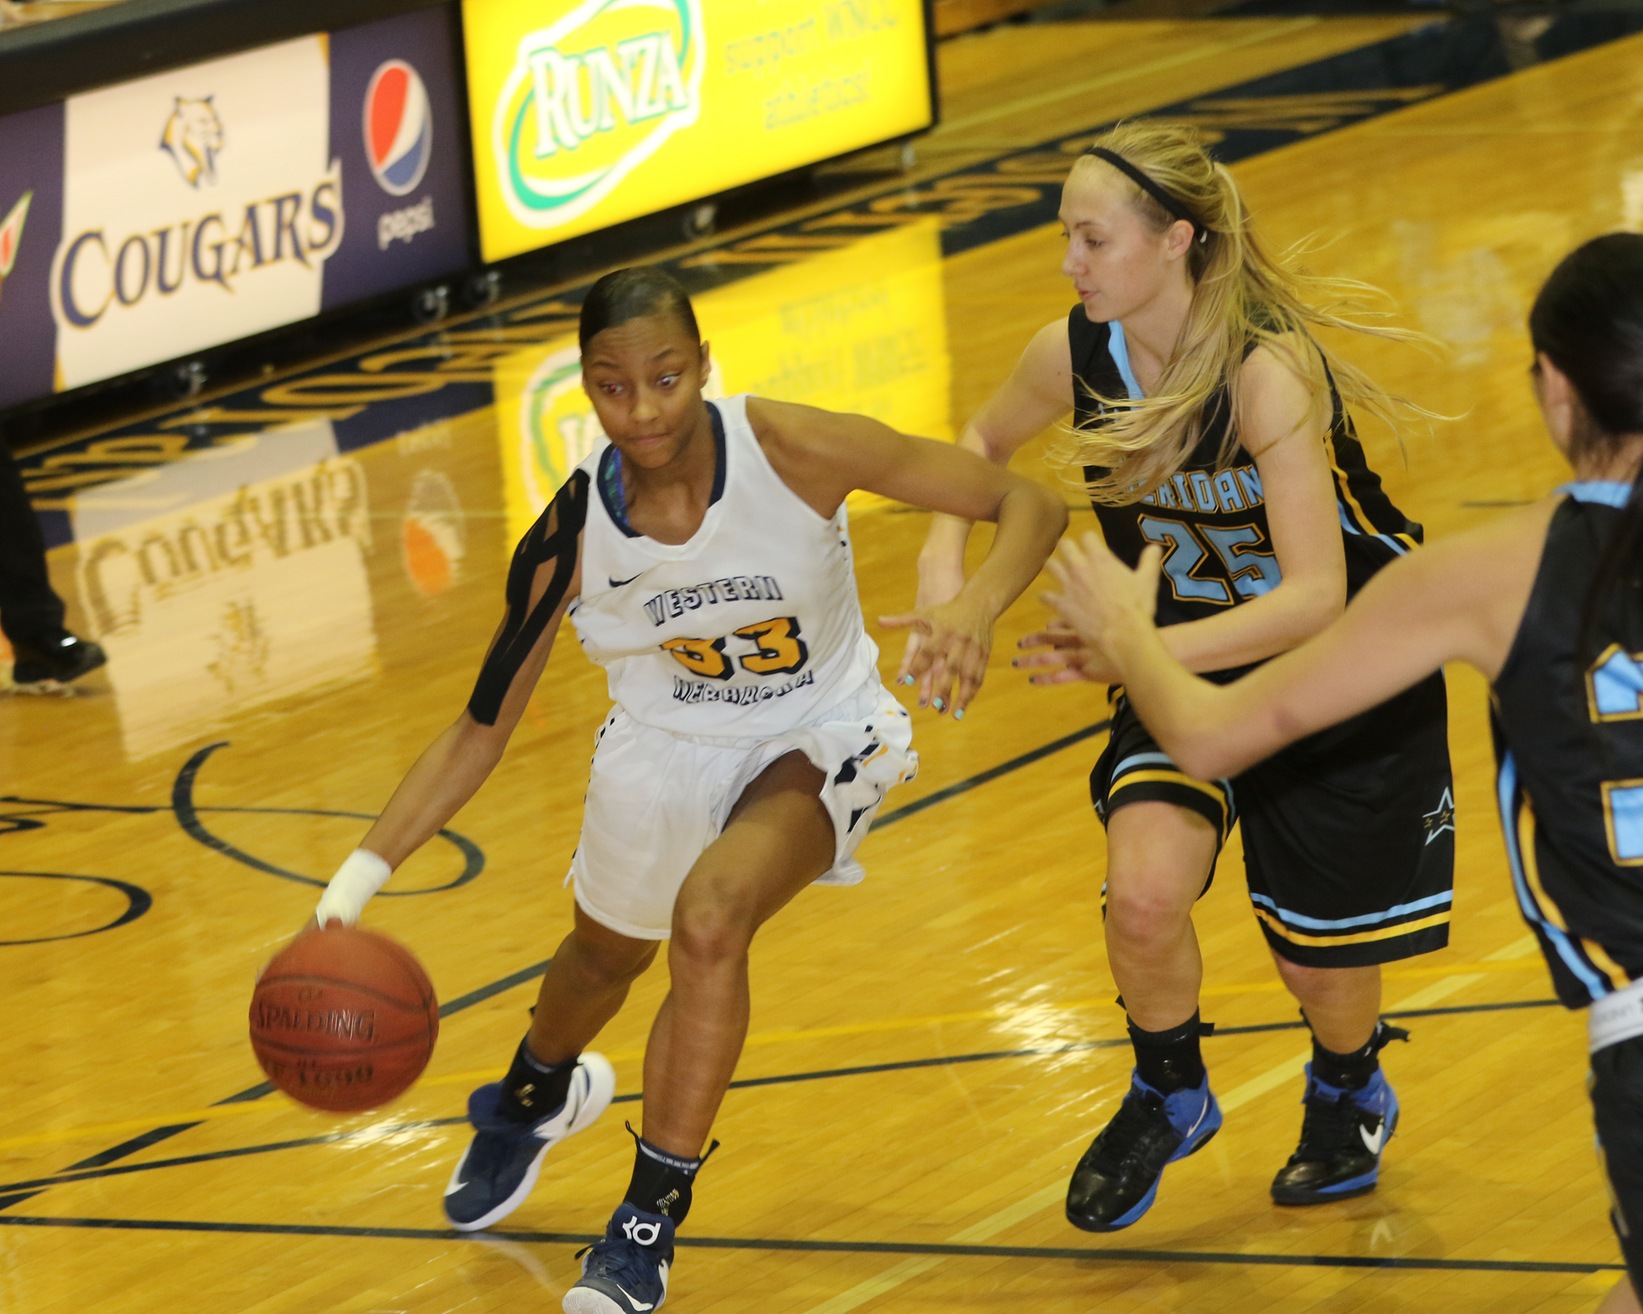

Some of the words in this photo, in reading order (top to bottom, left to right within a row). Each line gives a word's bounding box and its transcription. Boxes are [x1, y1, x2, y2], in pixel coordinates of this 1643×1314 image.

[529, 31, 690, 158] RUNZA
[59, 178, 339, 330] COUGARS
[377, 197, 434, 250] pepsi
[1137, 513, 1284, 606] 25
[643, 575, 785, 627] WESTERN
[659, 616, 809, 681] 33
[257, 1000, 376, 1045] SPALDING
